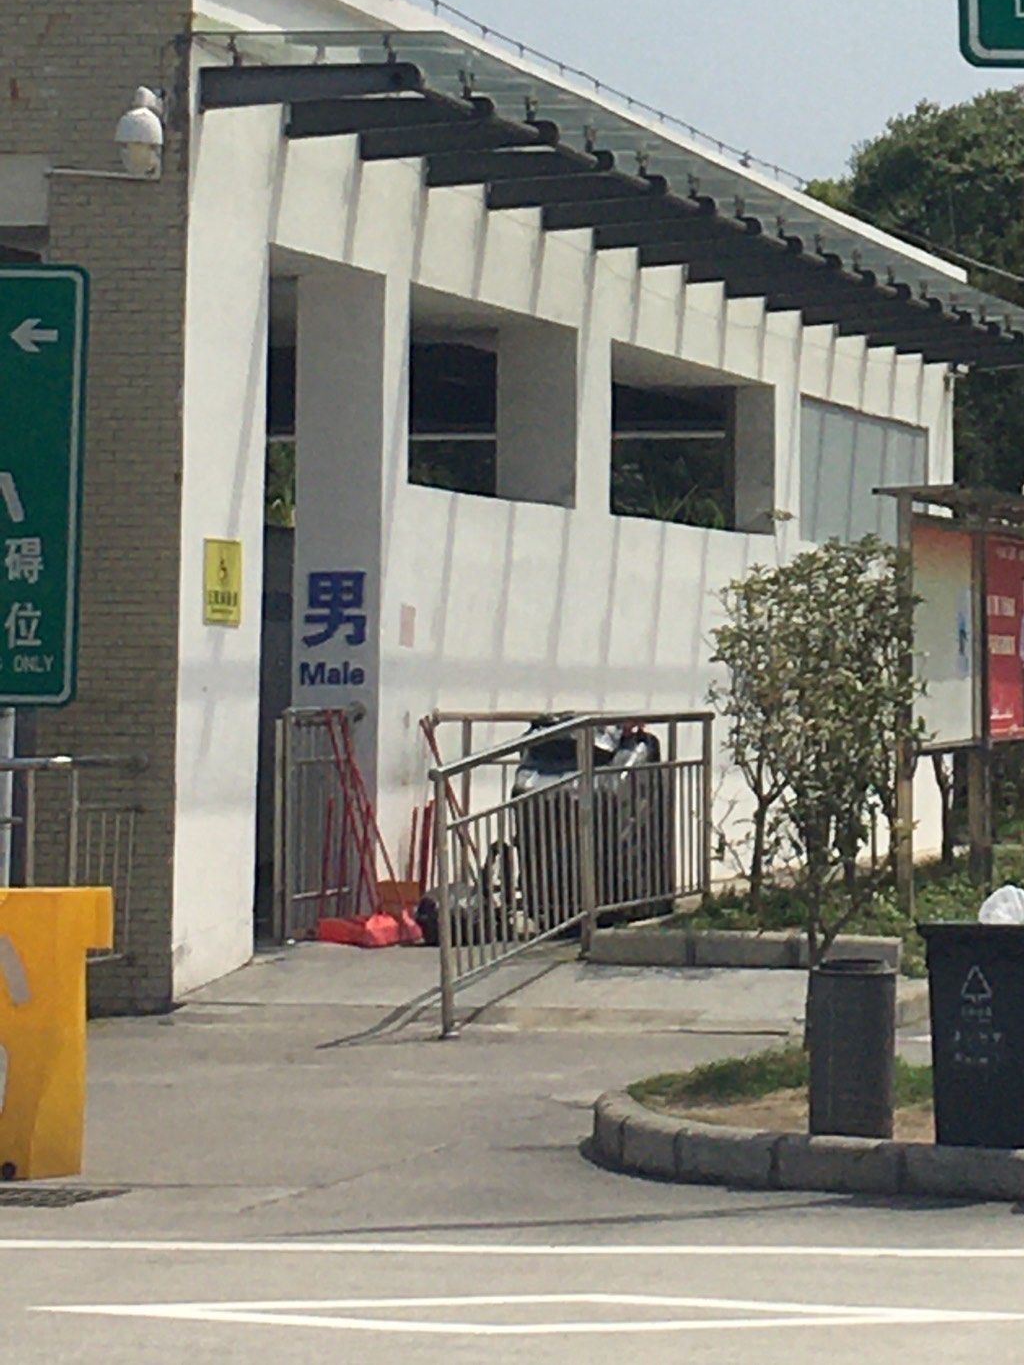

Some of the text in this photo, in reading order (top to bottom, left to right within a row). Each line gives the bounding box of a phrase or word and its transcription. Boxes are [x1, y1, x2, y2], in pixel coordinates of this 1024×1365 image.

[4, 601, 42, 650] 位
[302, 571, 367, 648] 男
[13, 654, 54, 673] ONLY
[300, 660, 365, 687] Male
